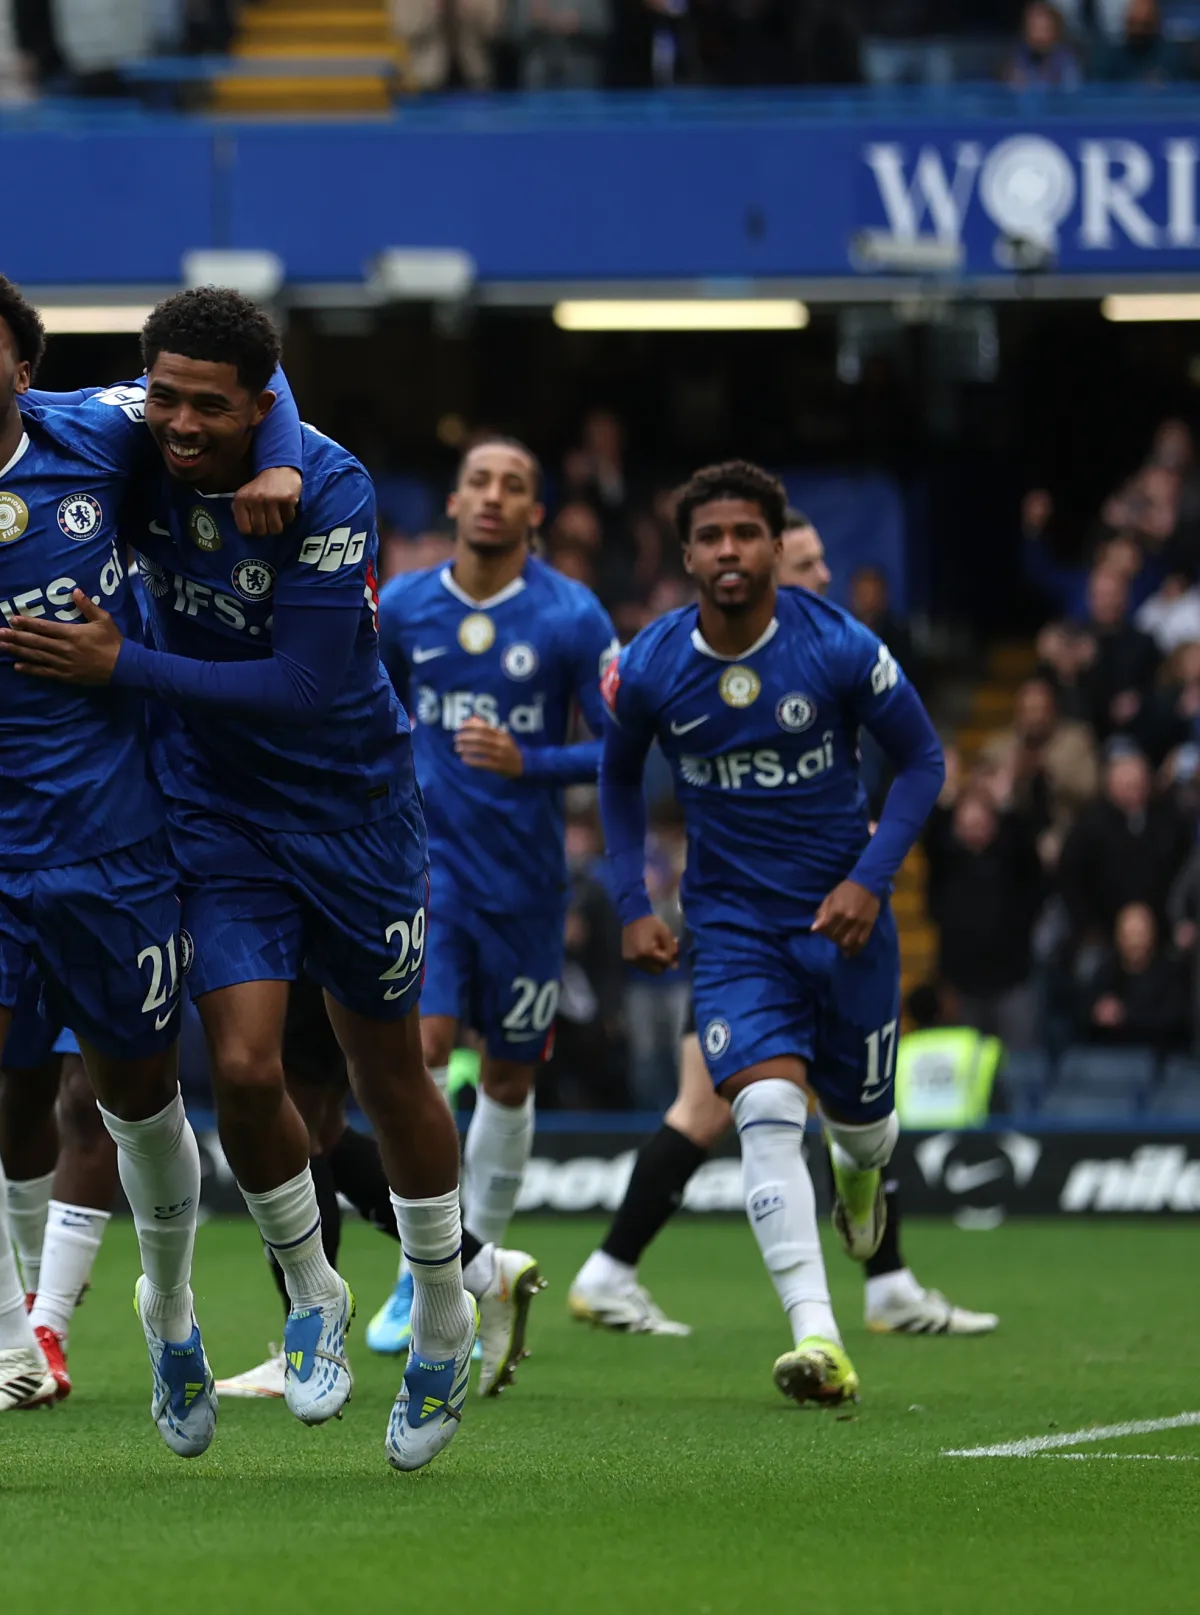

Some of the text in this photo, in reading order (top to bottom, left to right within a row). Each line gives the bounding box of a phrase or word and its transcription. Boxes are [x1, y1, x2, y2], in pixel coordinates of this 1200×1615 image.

[2, 525, 21, 539] FIFA
[60, 496, 87, 513] CHELSEA
[198, 537, 213, 549] FIFA
[239, 560, 269, 571] CHELSEA
[303, 540, 363, 557] FPT
[173, 573, 273, 636] IFS.
[715, 730, 834, 790] IFS.ai
[379, 907, 425, 980] 29
[137, 932, 180, 1013] 21
[501, 976, 560, 1032] 20
[862, 1018, 898, 1087] 17
[154, 1196, 193, 1213] CFC
[1059, 1143, 1200, 1213] nik
